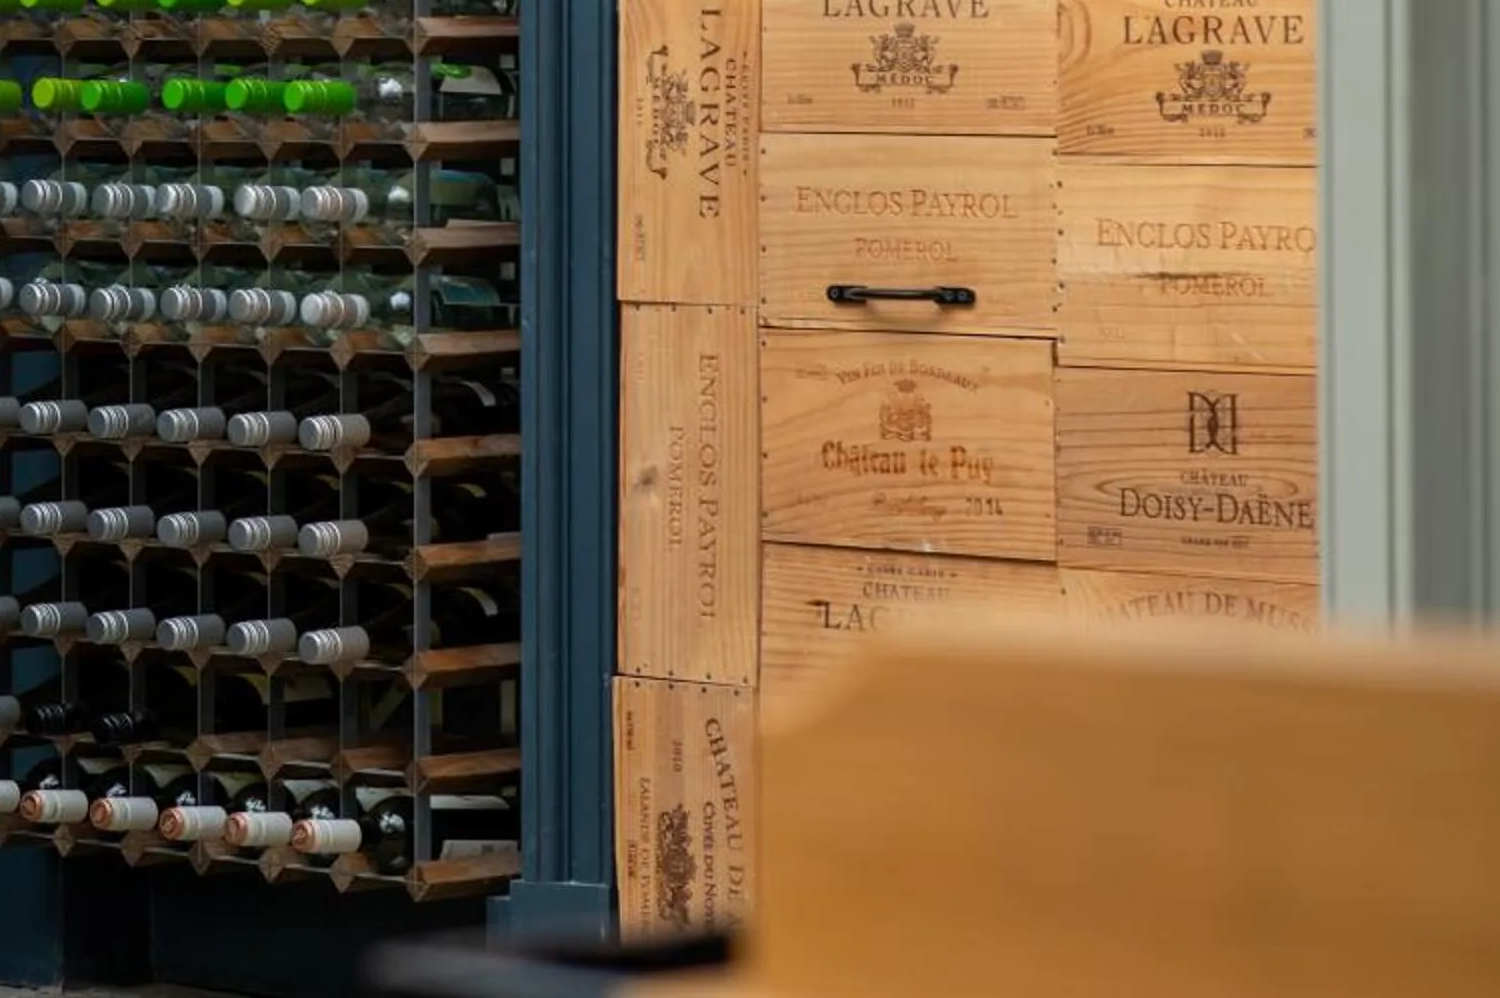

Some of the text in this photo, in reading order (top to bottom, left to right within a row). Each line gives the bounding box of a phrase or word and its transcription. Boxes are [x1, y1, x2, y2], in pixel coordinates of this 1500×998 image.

[1123, 15, 1304, 45] LAGRAVE
[699, 8, 721, 219] LAGRAVE
[725, 58, 737, 167] CHATEAU
[796, 186, 1018, 219] ENCLOS PAYROL
[854, 237, 958, 262] POMEROL
[1095, 217, 1316, 252] ENCLOS PAYRO
[1161, 277, 1274, 297] POMEROL
[822, 440, 906, 476] Château
[951, 445, 994, 484] Puy
[698, 353, 719, 626] ENCLOS PAYROL
[1120, 487, 1315, 529] DOISY-DAËNE
[1098, 590, 1194, 624] ATEAU
[1203, 591, 1240, 618] DE
[704, 718, 744, 851] CHATEAU
[727, 865, 744, 901] DE
